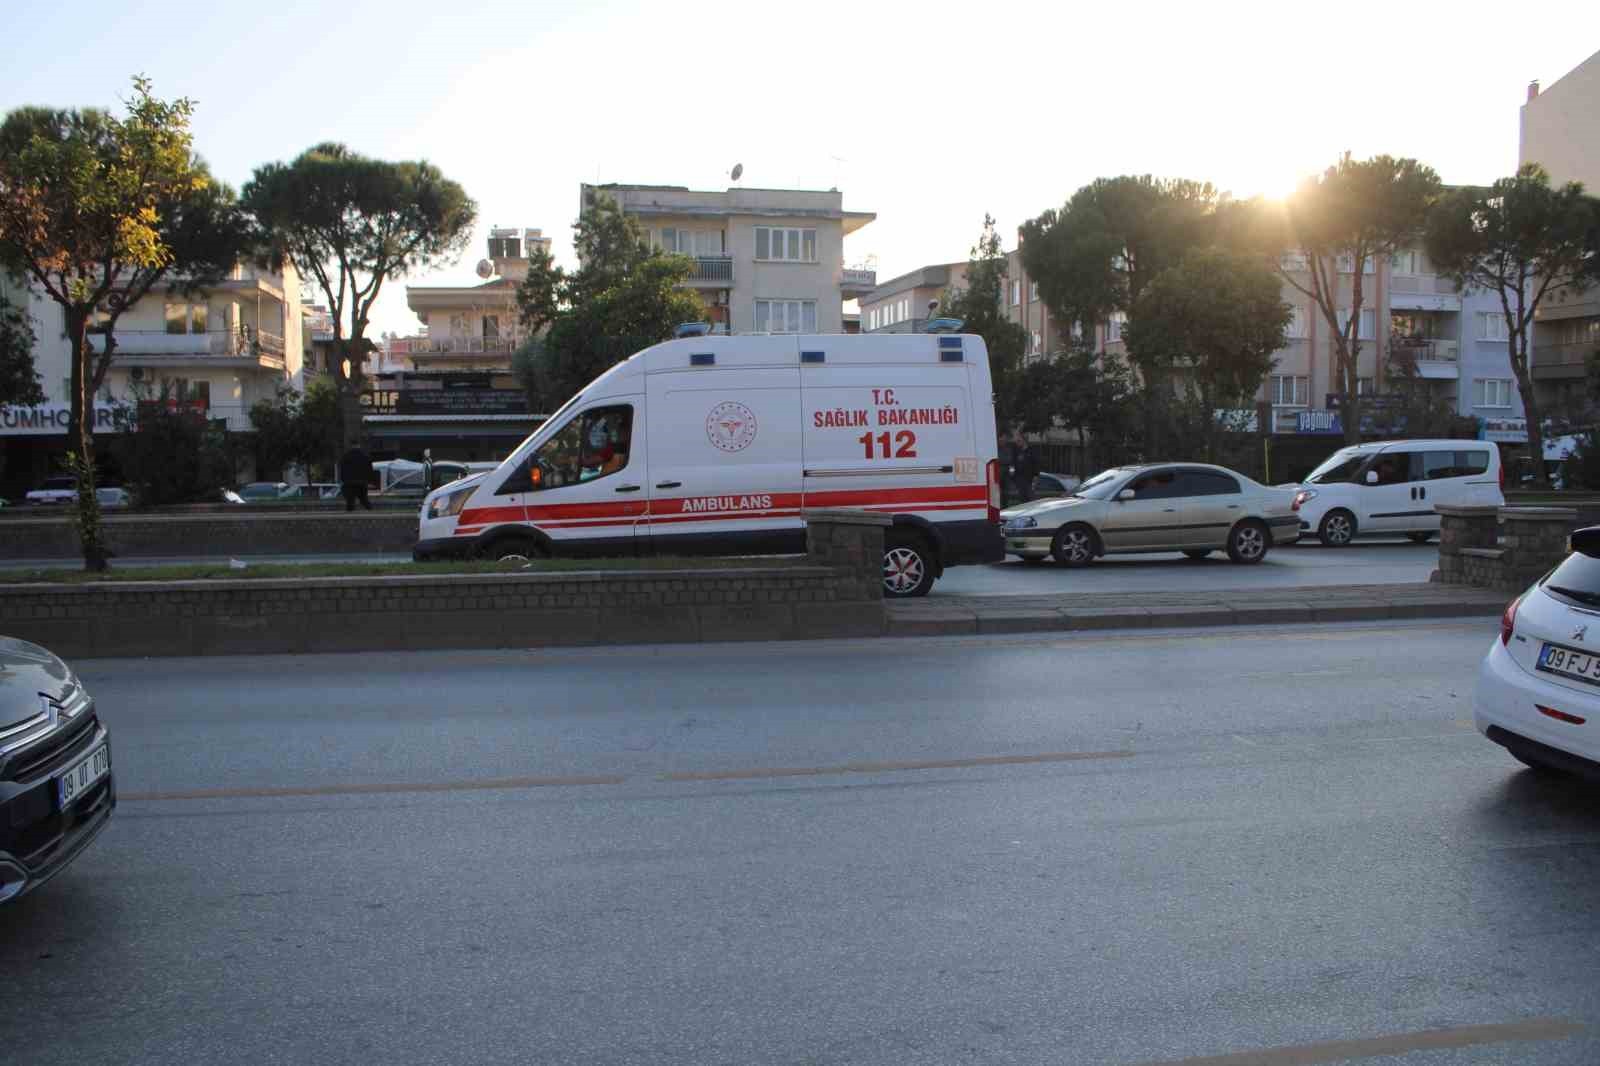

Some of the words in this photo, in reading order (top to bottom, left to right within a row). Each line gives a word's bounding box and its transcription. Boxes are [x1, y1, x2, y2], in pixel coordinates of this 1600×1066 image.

[872, 389, 899, 405] T.C.
[0, 408, 71, 428] UMHO
[814, 407, 869, 428] SAĞLIK
[878, 405, 958, 426] BAKANLIĞI
[859, 430, 917, 459] 112
[682, 494, 773, 512] AMBULANS
[1546, 648, 1565, 667] 09
[1566, 654, 1591, 673] FJ
[64, 774, 73, 799] 09
[79, 762, 89, 787] UT
